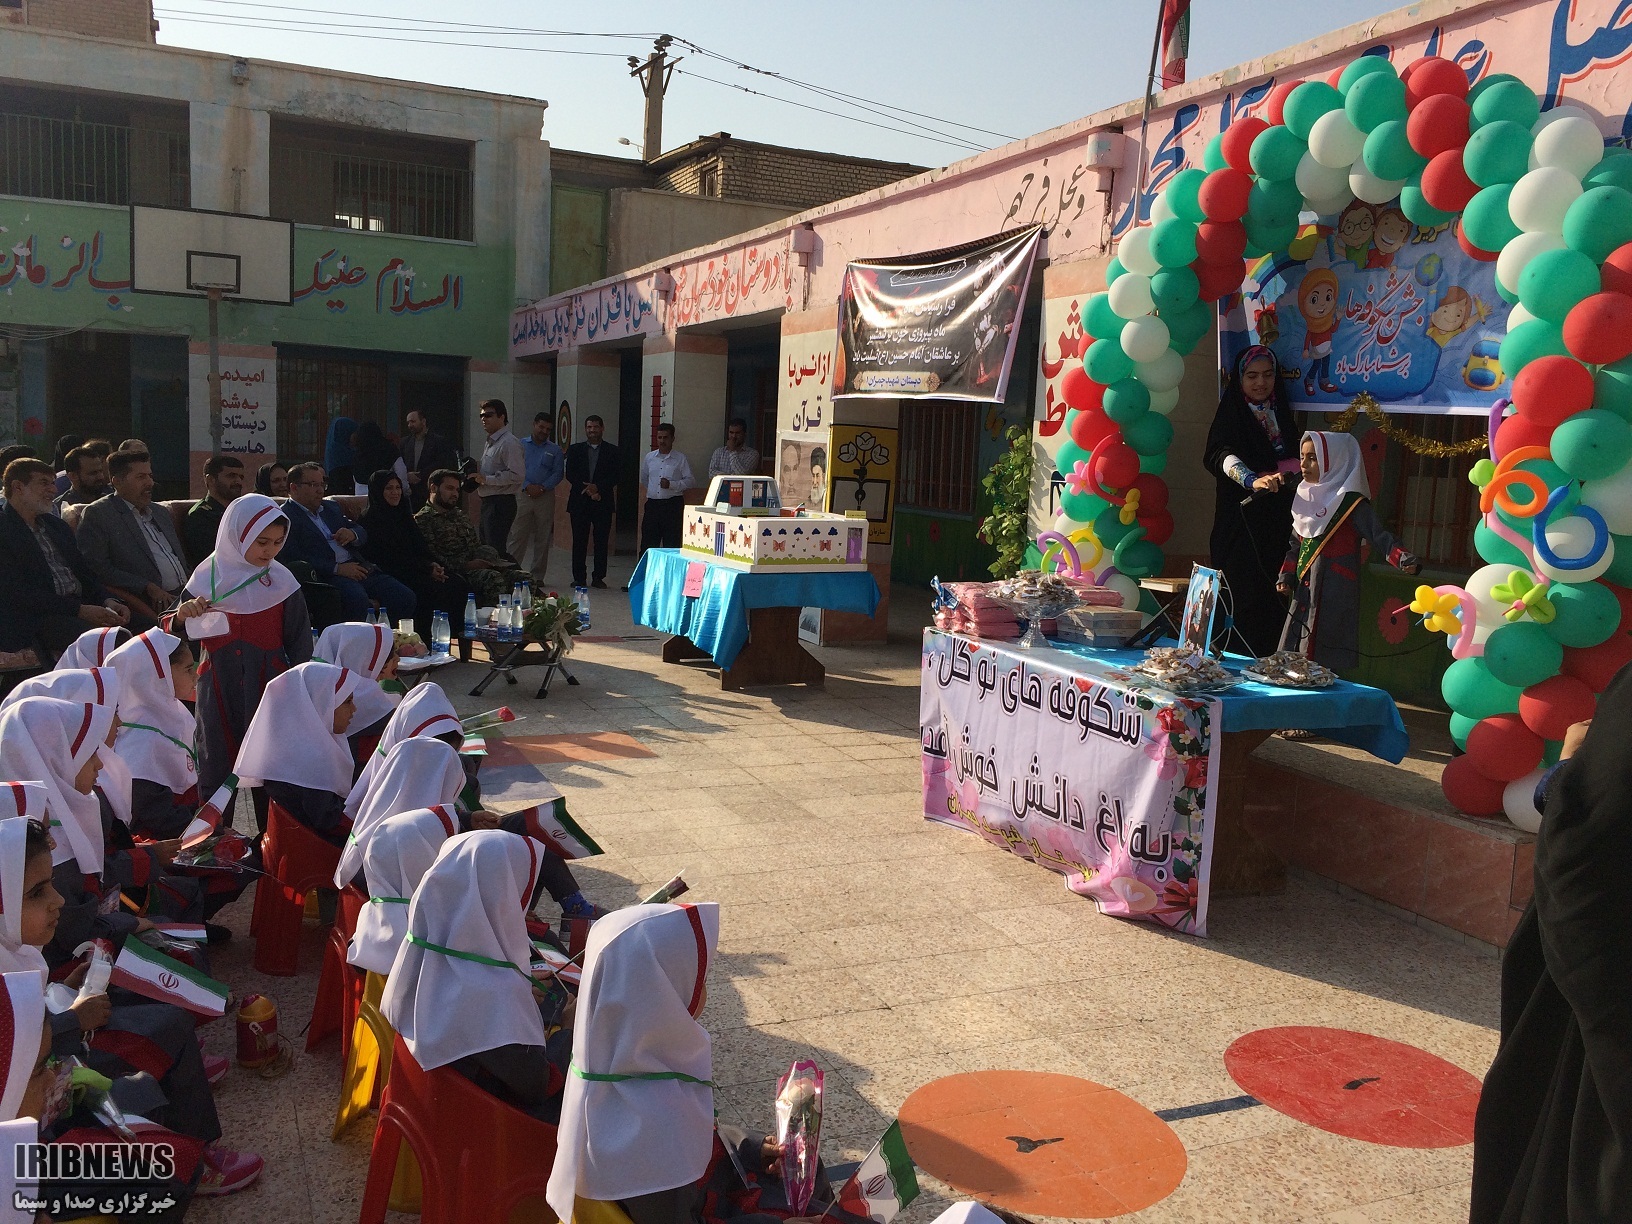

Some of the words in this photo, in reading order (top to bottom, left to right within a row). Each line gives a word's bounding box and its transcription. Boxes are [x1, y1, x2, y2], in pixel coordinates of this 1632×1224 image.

[375, 257, 460, 314] السلام
[707, 253, 730, 309] خود
[725, 245, 781, 314] دوستان
[784, 233, 794, 310] با
[624, 282, 633, 333] با
[1377, 283, 1424, 346] جشن
[892, 326, 908, 344] خون
[908, 327, 933, 343] پیروزی
[933, 324, 946, 338] ماه
[795, 351, 821, 386] انس
[819, 351, 831, 385] از
[852, 350, 860, 364] باد
[860, 349, 880, 364] تسلیت
[888, 350, 908, 365] حسین
[924, 346, 952, 363] عاشقان
[951, 350, 961, 365] بر
[1336, 355, 1347, 383] باد
[1348, 338, 1375, 381] مبارک
[1376, 347, 1411, 373] شما
[1397, 358, 1411, 378] بر
[788, 354, 796, 388] با
[867, 375, 886, 387] چمران
[886, 375, 900, 387] شهید
[901, 375, 922, 387] دبستان
[220, 392, 241, 409] شم
[241, 398, 259, 415] به
[792, 395, 822, 432] قرآن
[221, 415, 267, 434] دبستان
[220, 440, 265, 453] هاست
[938, 638, 971, 687] گل
[978, 651, 997, 701] نو
[1001, 661, 1042, 714] های
[1049, 676, 1141, 746] شکوفه
[953, 725, 999, 796] خوش
[1012, 755, 1086, 831] دانش
[1130, 824, 1170, 878] به
